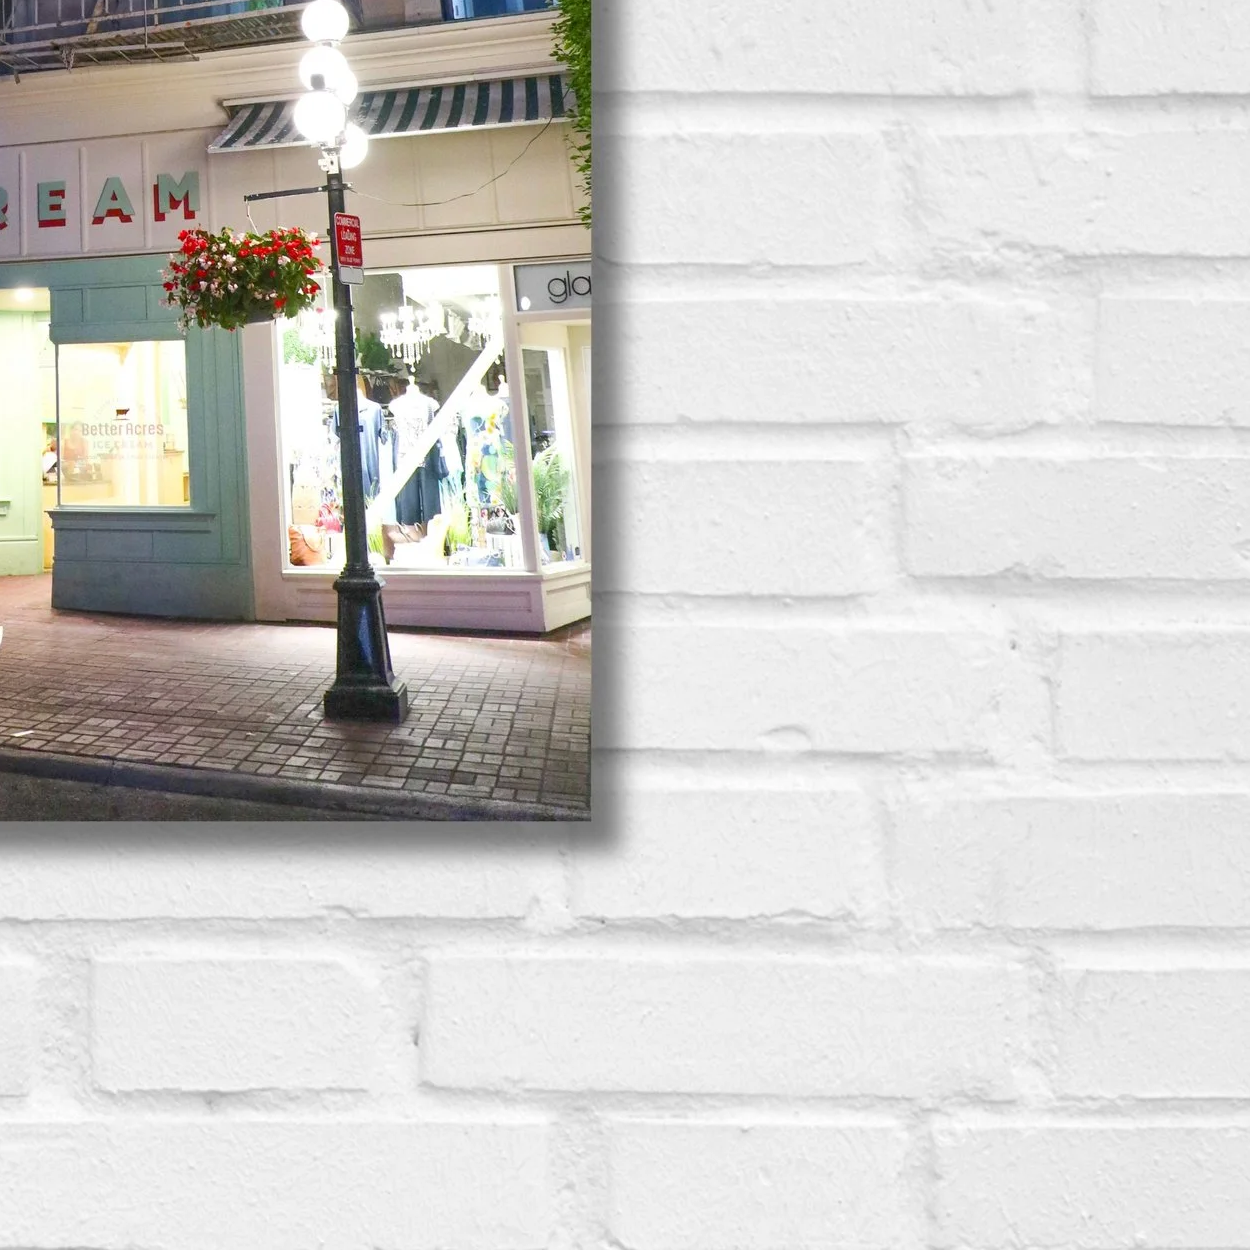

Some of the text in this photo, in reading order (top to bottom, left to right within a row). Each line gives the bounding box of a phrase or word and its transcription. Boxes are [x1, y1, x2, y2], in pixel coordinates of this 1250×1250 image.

[340, 231, 357, 241] LOADING
[344, 245, 355, 255] ZONE
[548, 270, 592, 303] gla
[82, 423, 164, 436] Better Acres
[93, 440, 153, 449] ICE CREAM
